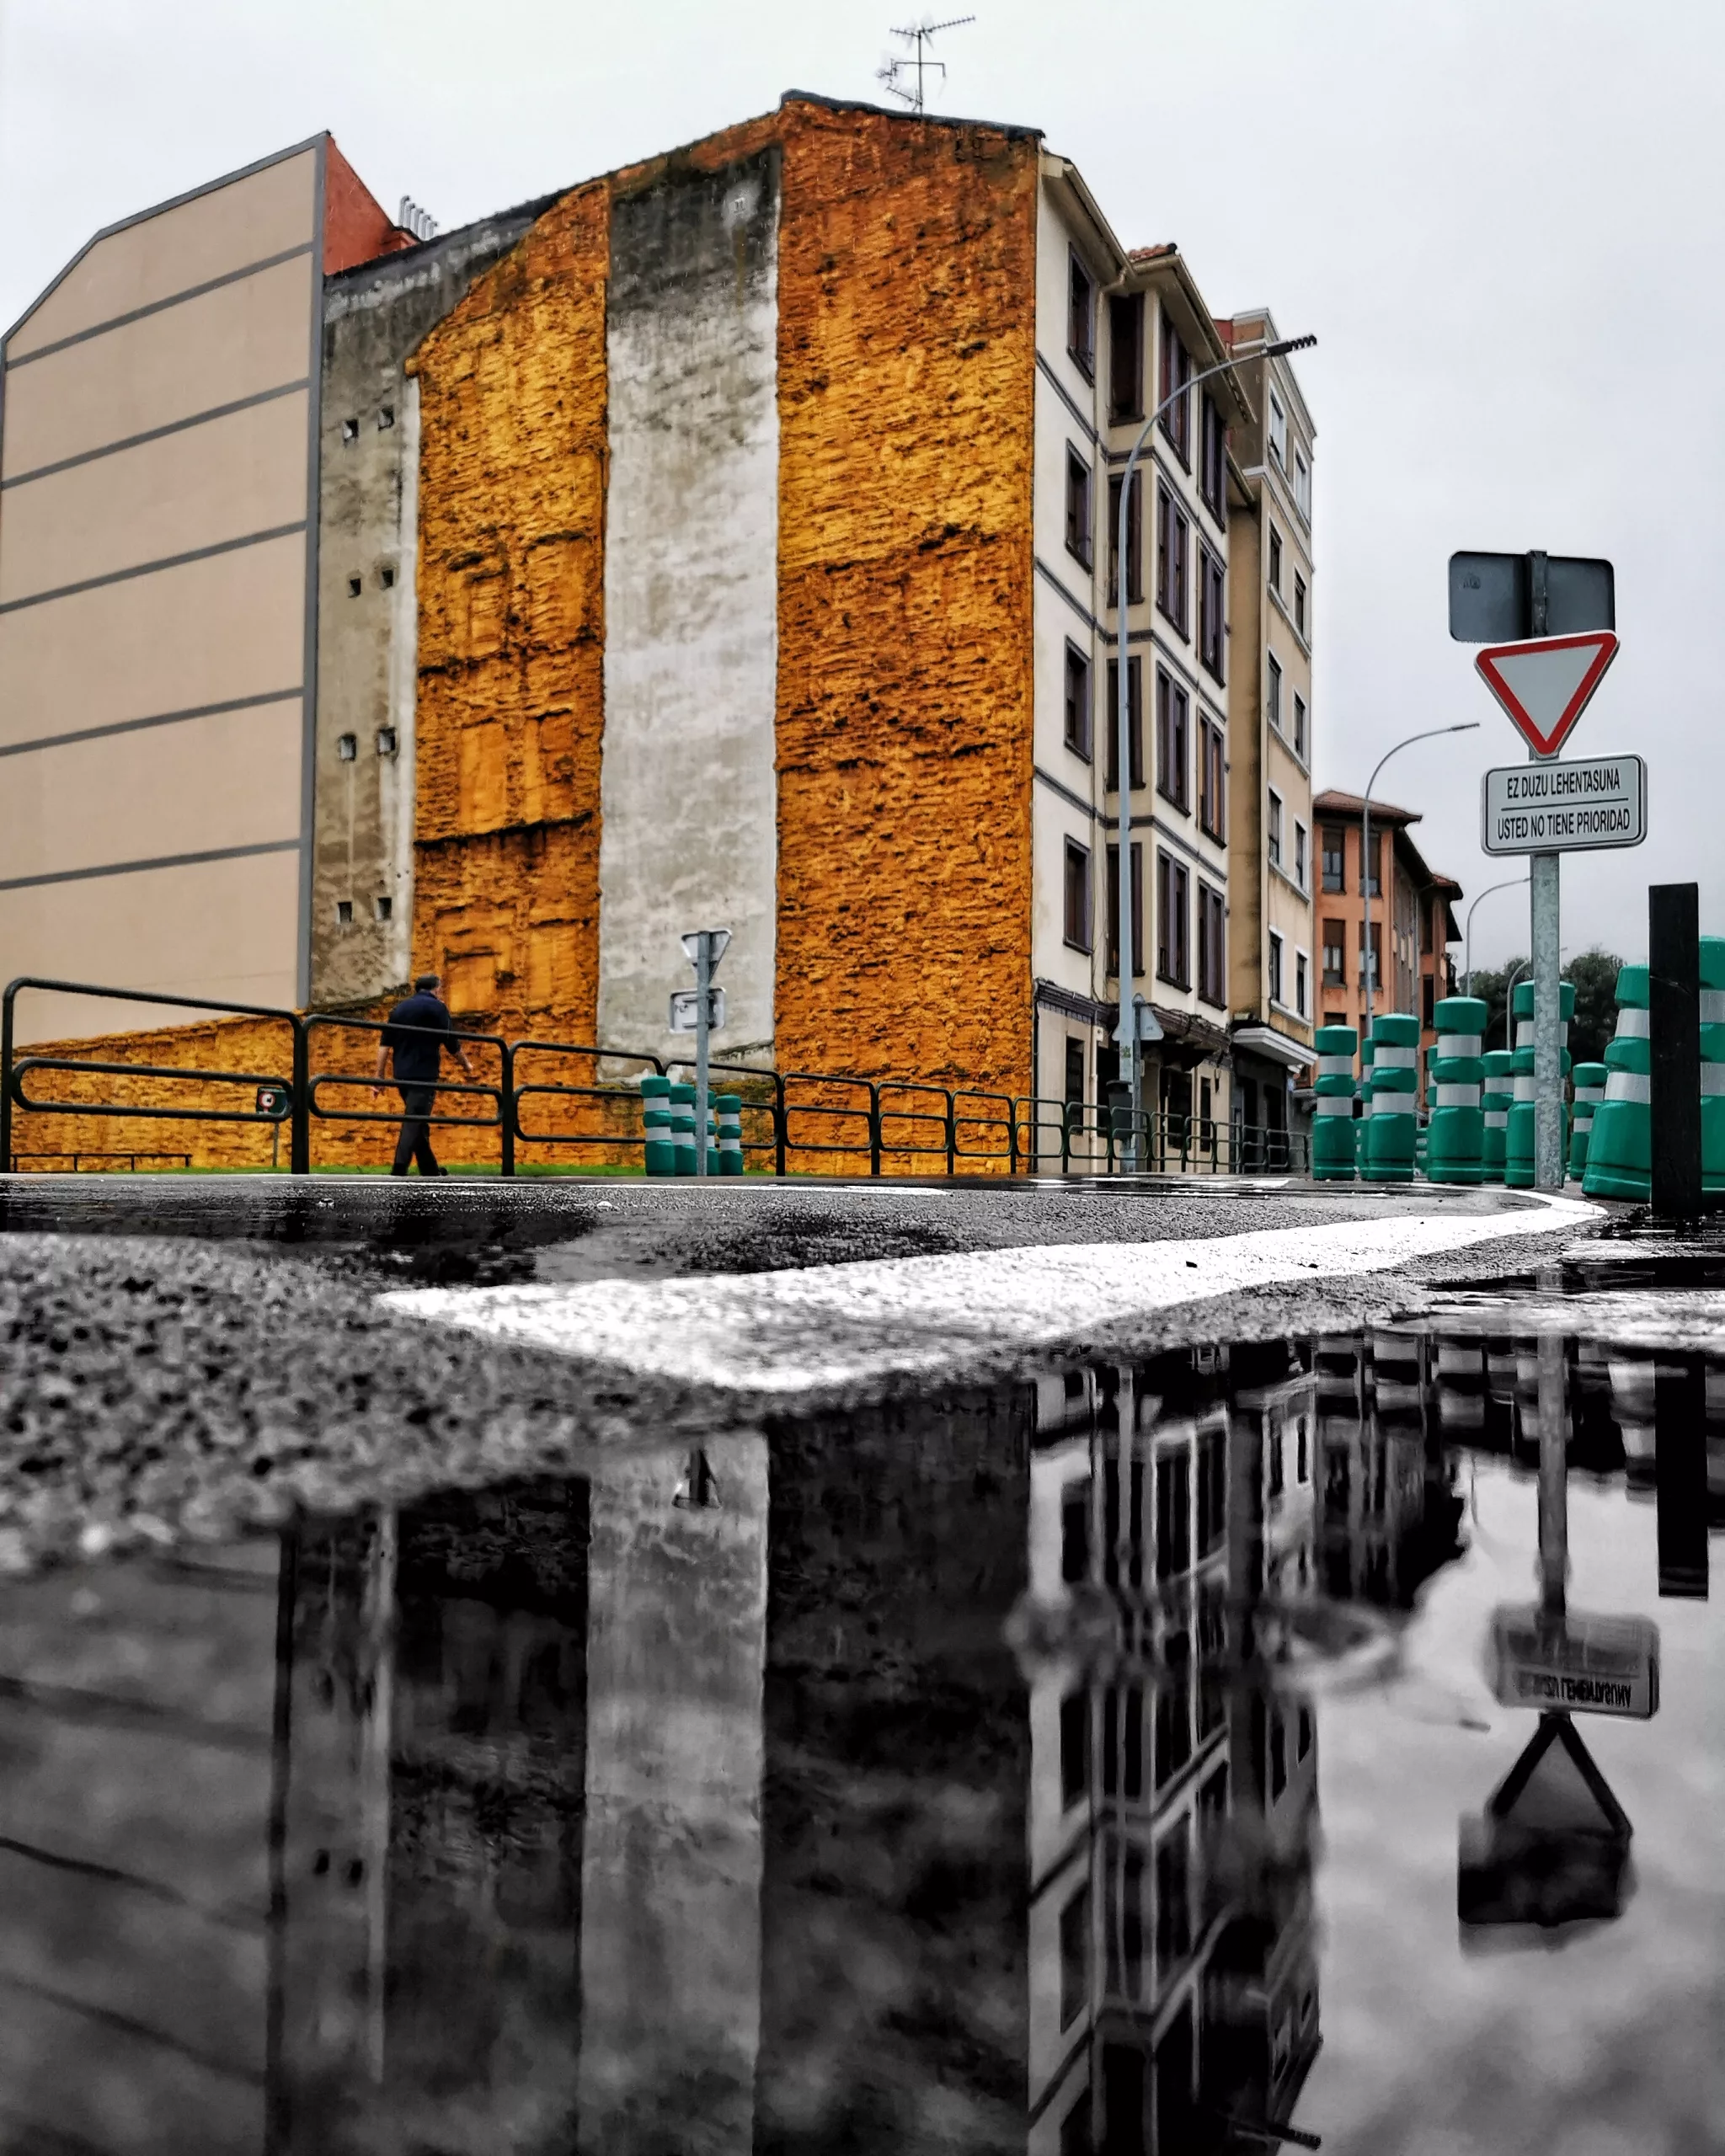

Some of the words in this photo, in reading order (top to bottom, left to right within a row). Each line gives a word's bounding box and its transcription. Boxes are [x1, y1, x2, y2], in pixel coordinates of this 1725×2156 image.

[1507, 777, 1519, 799] EZ
[1522, 774, 1548, 798] DUZU
[1551, 768, 1621, 795] LEHENTASUNA
[1498, 815, 1529, 841] USTED
[1530, 813, 1545, 837] NO
[1547, 811, 1574, 835] TIENE
[1577, 808, 1630, 833] PRIORIDAD
